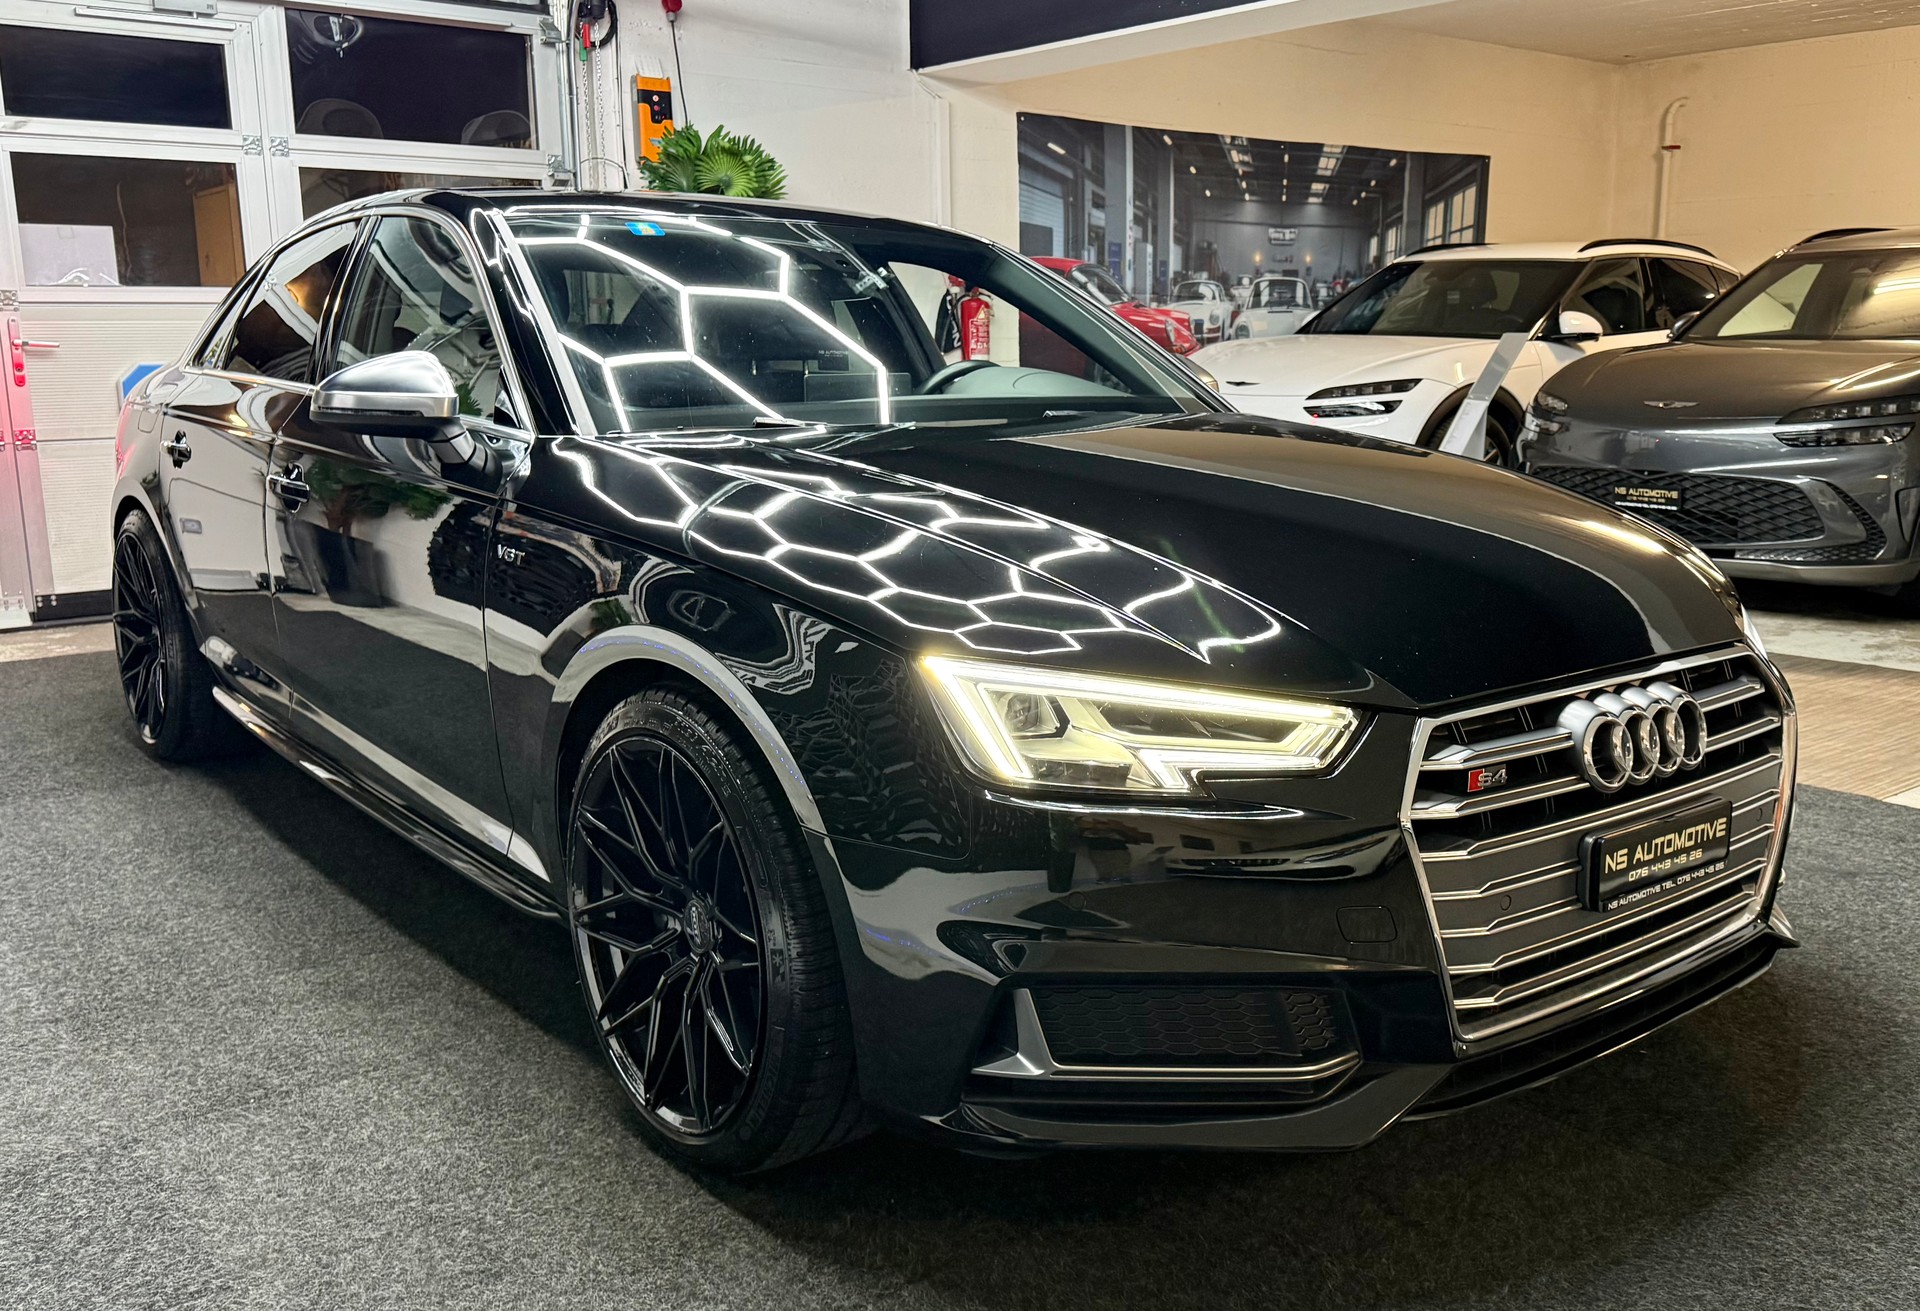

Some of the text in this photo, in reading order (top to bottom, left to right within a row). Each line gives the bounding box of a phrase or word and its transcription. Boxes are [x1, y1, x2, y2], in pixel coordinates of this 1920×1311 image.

[1614, 486, 1627, 495] NS
[1628, 488, 1679, 499] AUTOMOTIVE
[1477, 767, 1508, 787] S4
[1604, 816, 1728, 874] NS AUTOMOTIVE
[1628, 848, 1703, 882] 076 443 45 26
[1607, 901, 1618, 911] NS
[1618, 885, 1661, 906] AUTOMOTIVE
